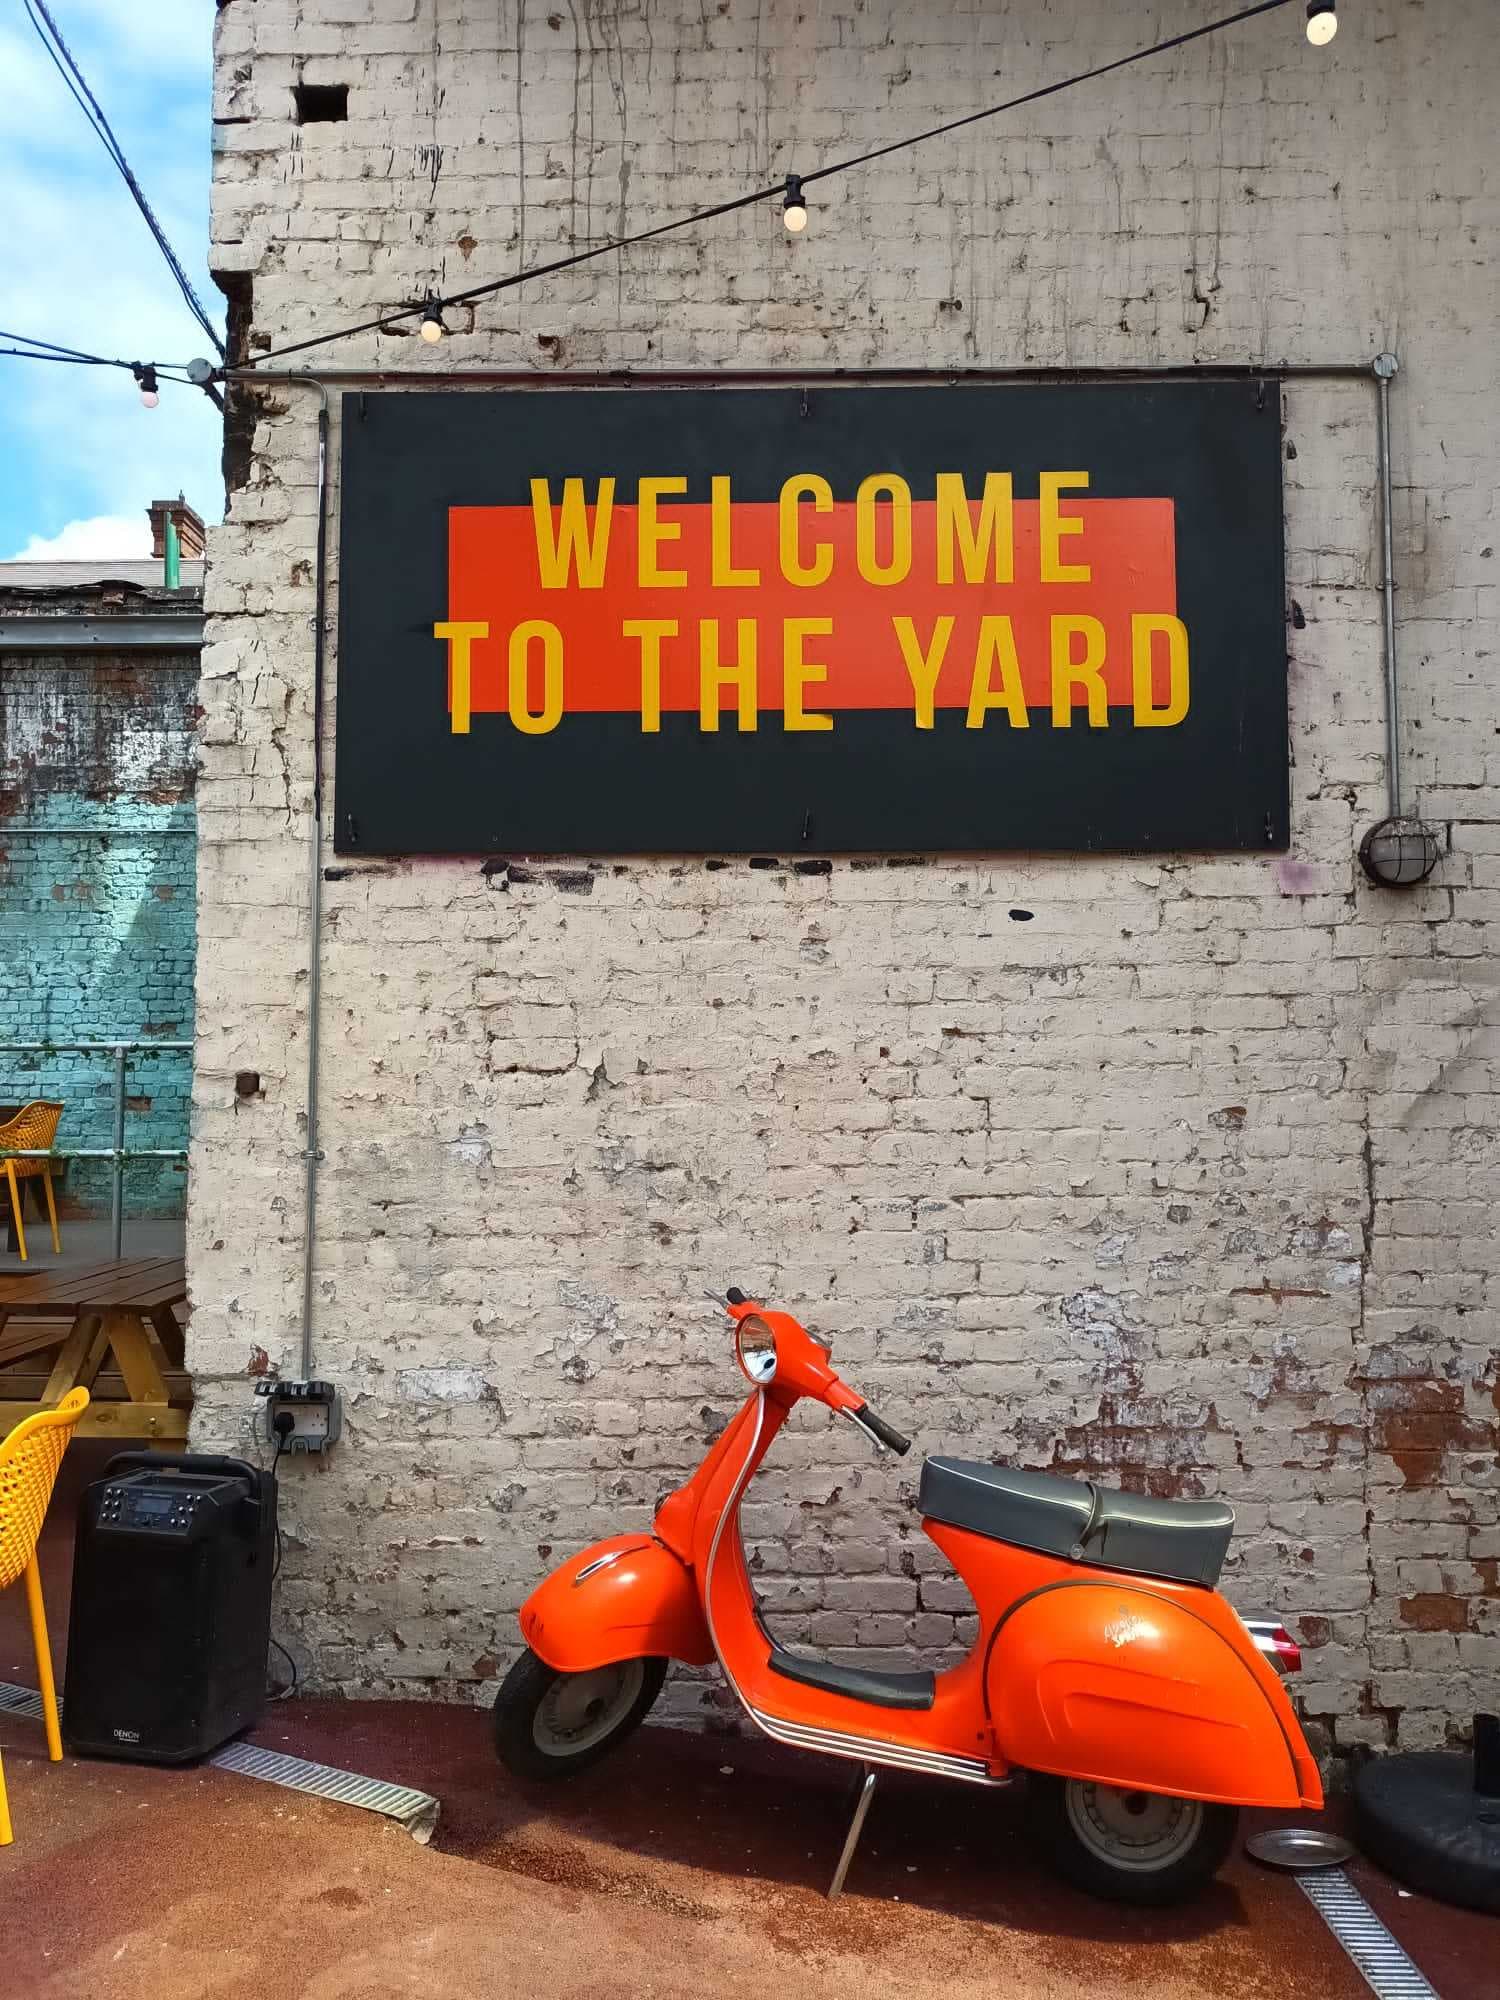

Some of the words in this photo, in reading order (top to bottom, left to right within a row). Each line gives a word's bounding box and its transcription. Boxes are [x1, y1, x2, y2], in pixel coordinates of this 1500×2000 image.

[530, 470, 1091, 589] WELCOME
[433, 620, 564, 735] TO
[622, 617, 834, 733] THE
[892, 613, 1190, 730] YARD
[113, 1729, 140, 1739] DENON
